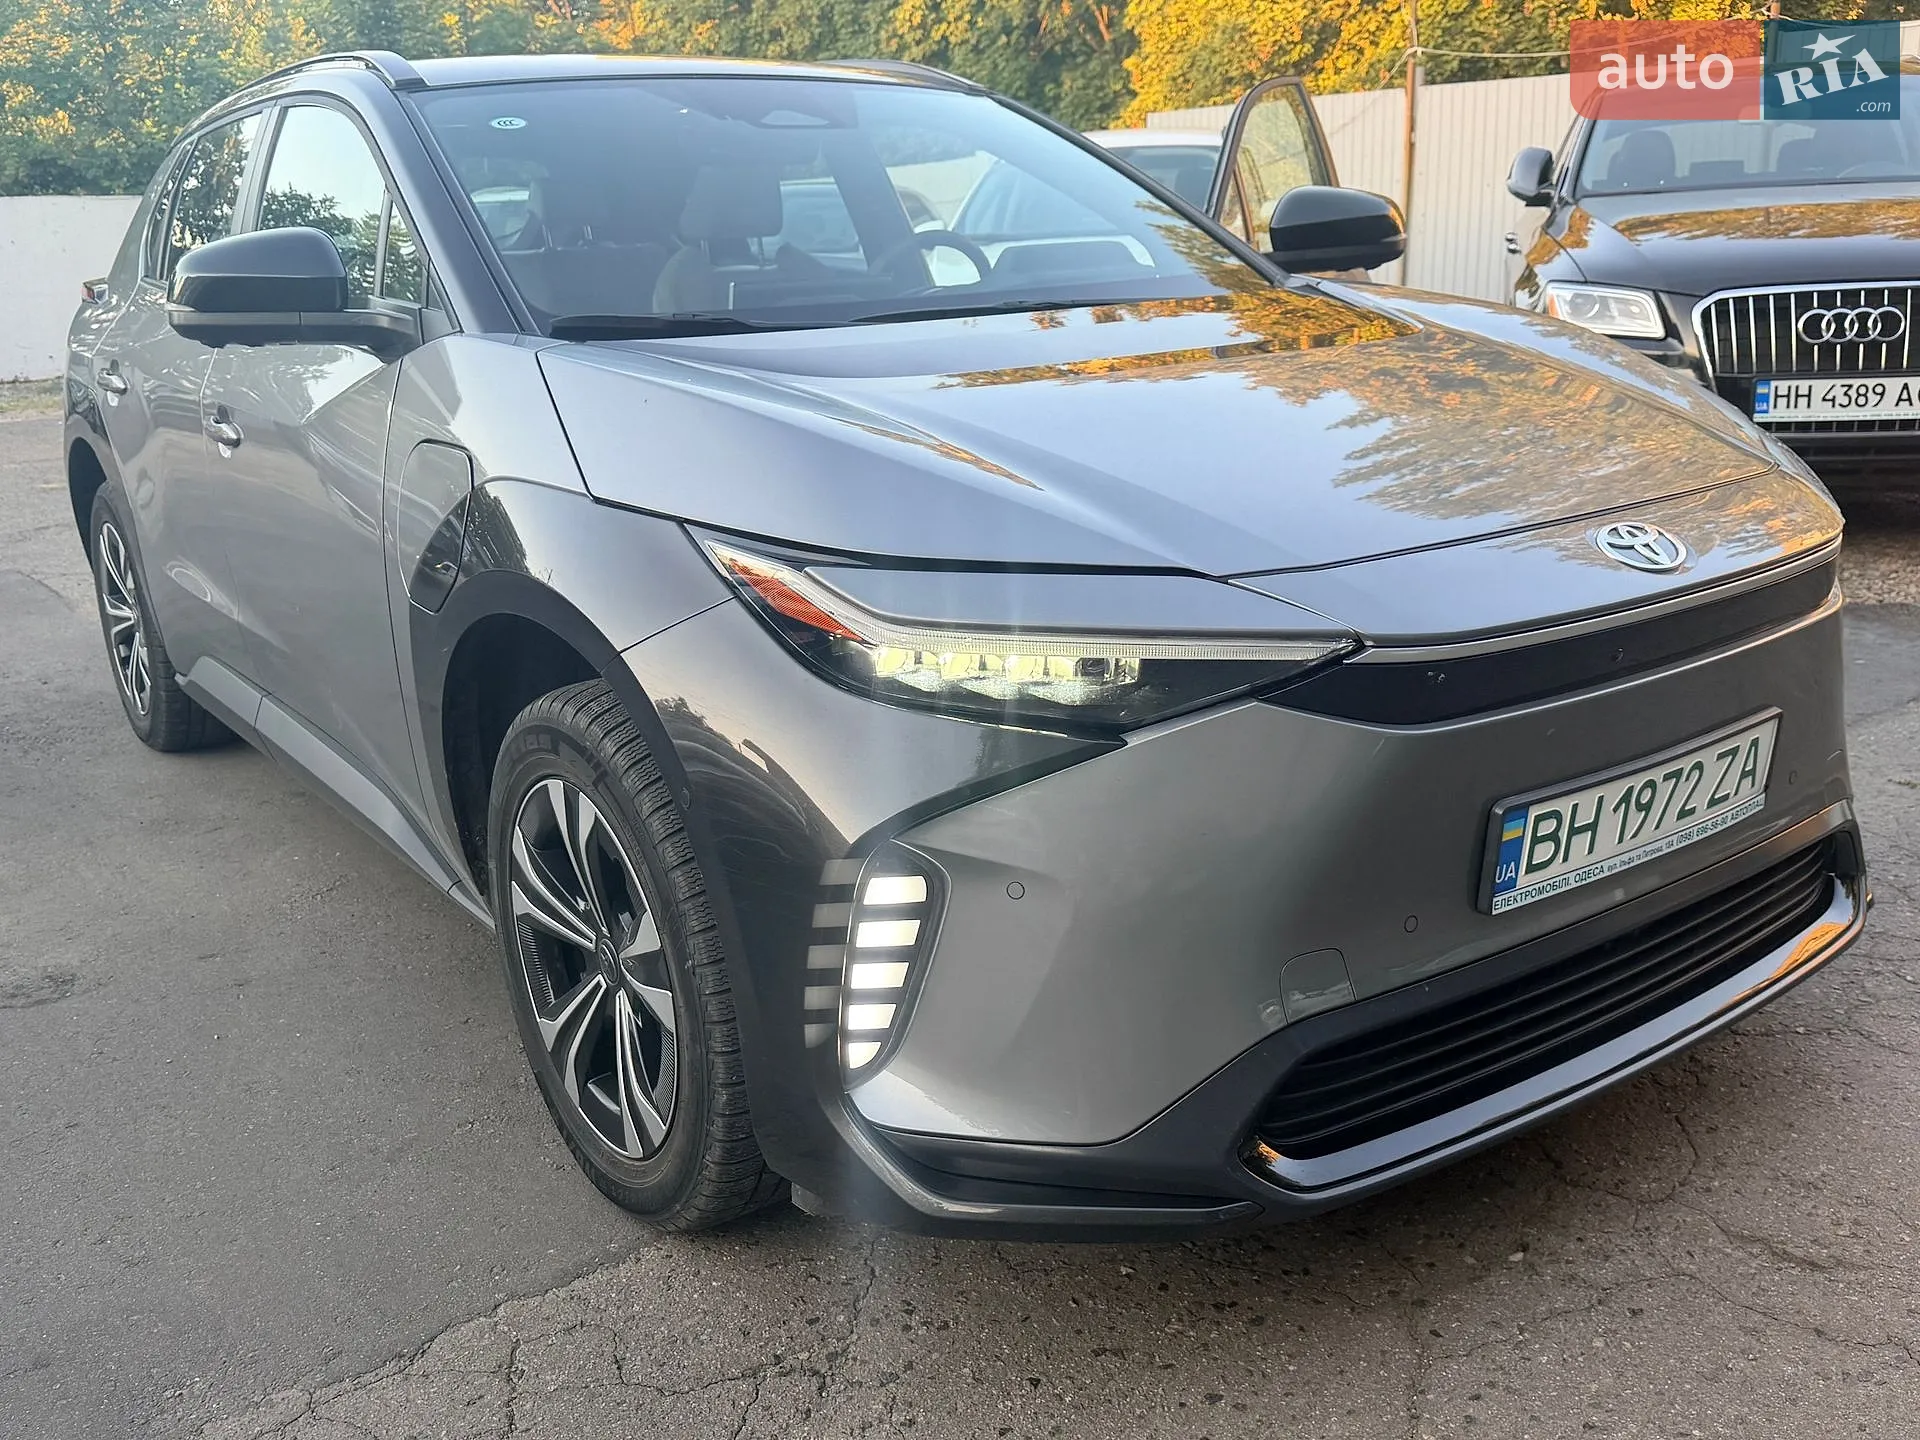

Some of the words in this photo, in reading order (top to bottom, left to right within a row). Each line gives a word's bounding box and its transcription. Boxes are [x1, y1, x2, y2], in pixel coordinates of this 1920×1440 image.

[1773, 384, 1812, 409] HH
[1821, 383, 1886, 409] 4389
[1895, 382, 1920, 407] A
[1524, 794, 1604, 876] BH
[1612, 759, 1705, 846] 1972
[1705, 736, 1761, 810] ZA
[1496, 862, 1516, 884] UA
[1574, 866, 1605, 884] ОДЕСА
